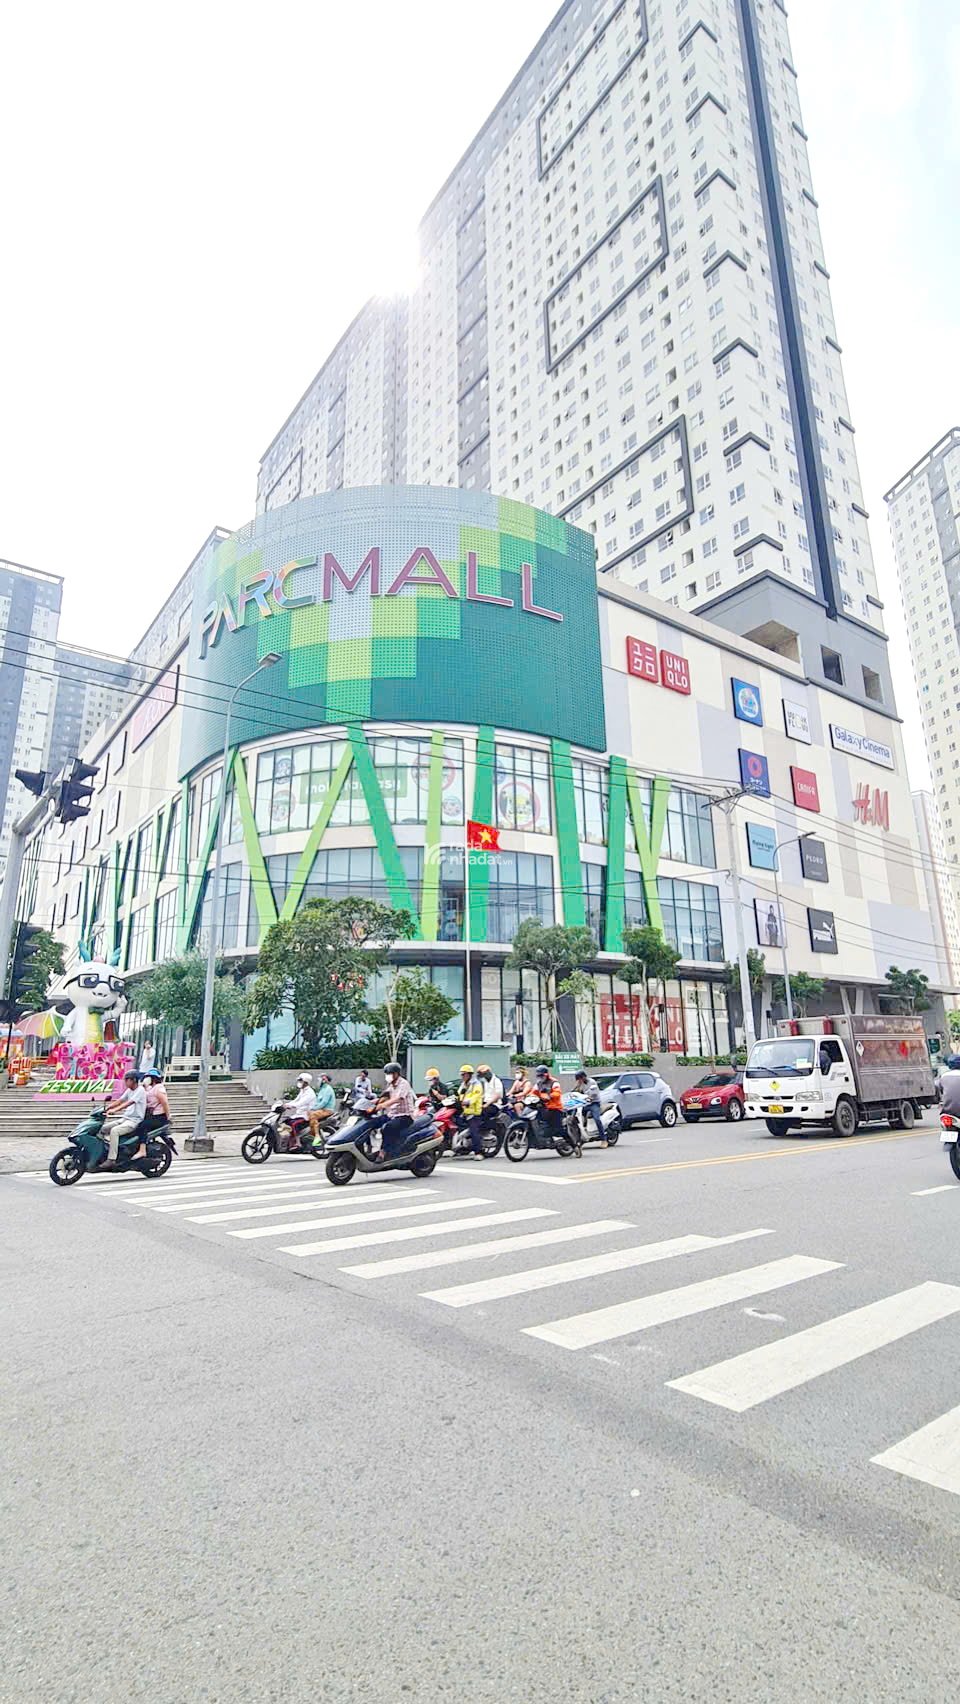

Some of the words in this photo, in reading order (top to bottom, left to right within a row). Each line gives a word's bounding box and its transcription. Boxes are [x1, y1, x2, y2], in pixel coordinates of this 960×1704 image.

[834, 727, 862, 750] Galaxy
[862, 738, 890, 759] Cinema
[851, 781, 890, 832] H&M
[806, 854, 824, 865] PEDRO
[39, 1080, 114, 1093] FESTIVAL
